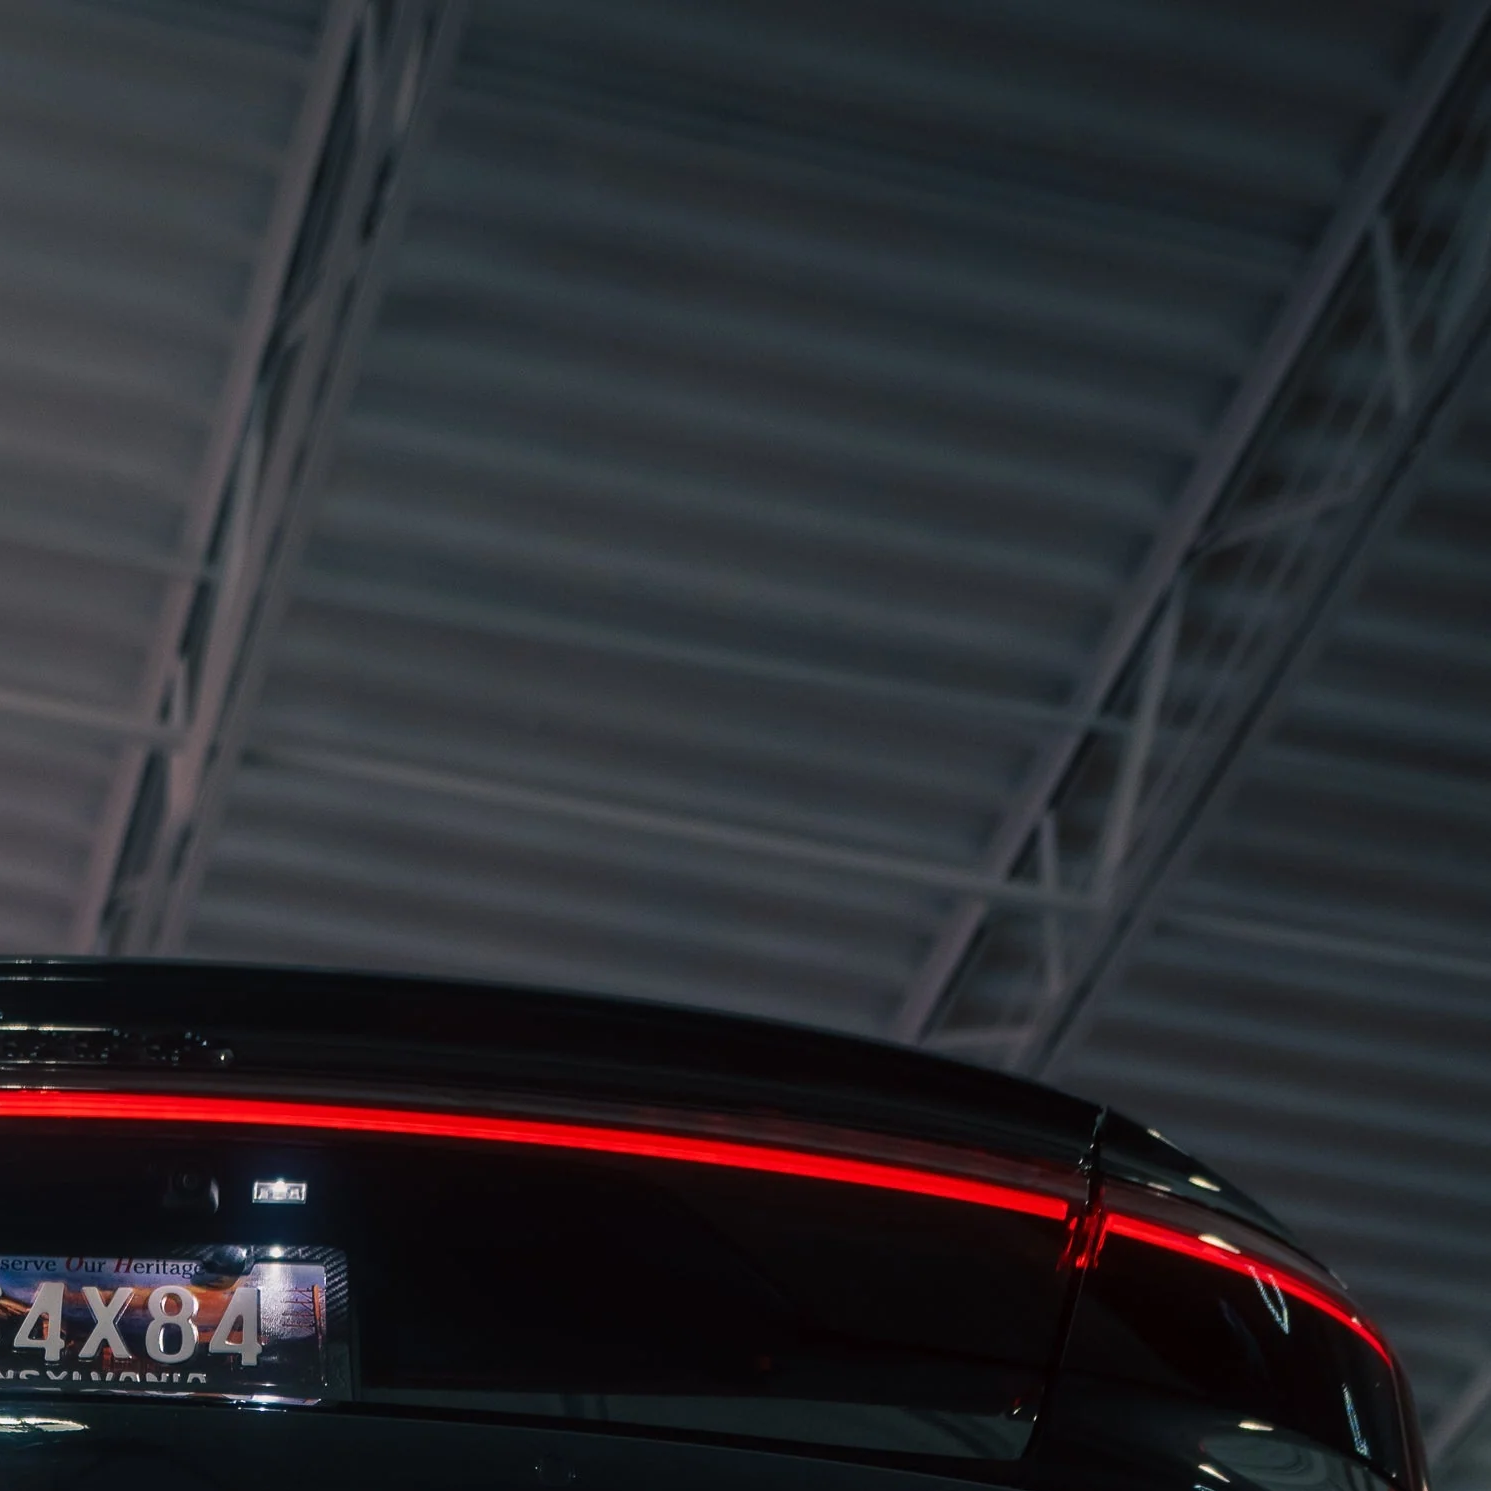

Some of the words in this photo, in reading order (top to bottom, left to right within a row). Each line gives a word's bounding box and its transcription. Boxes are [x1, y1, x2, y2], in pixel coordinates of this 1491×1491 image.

[65, 1256, 106, 1274] Our
[112, 1257, 206, 1279] Heritage
[13, 1281, 264, 1368] 4X84
